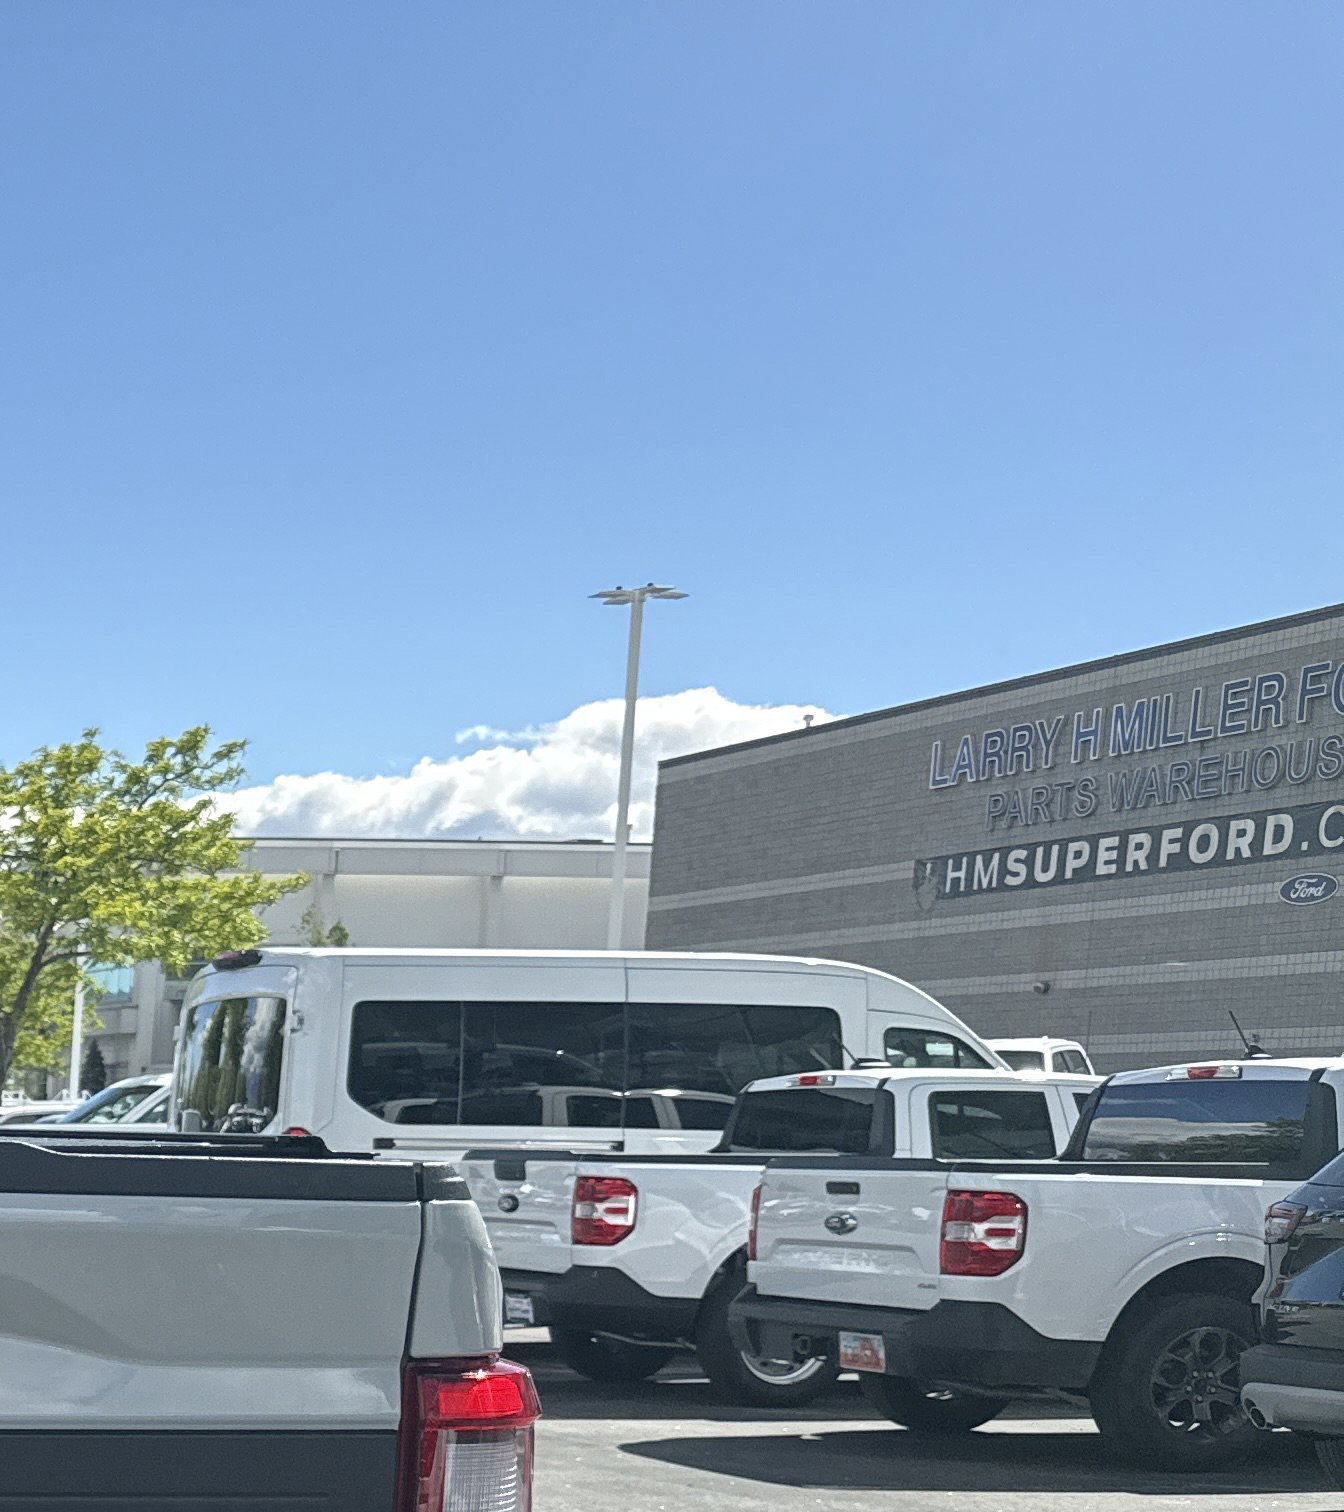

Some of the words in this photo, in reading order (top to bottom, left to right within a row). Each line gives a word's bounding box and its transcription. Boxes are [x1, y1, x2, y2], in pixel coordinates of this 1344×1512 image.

[928, 715, 1063, 790] LARRY
[1070, 707, 1103, 764] H
[1109, 671, 1287, 757] MILLER
[986, 774, 1097, 831] PARTS
[925, 804, 1344, 894] HMSUPERFORD.C
[1290, 877, 1326, 899] Ford
